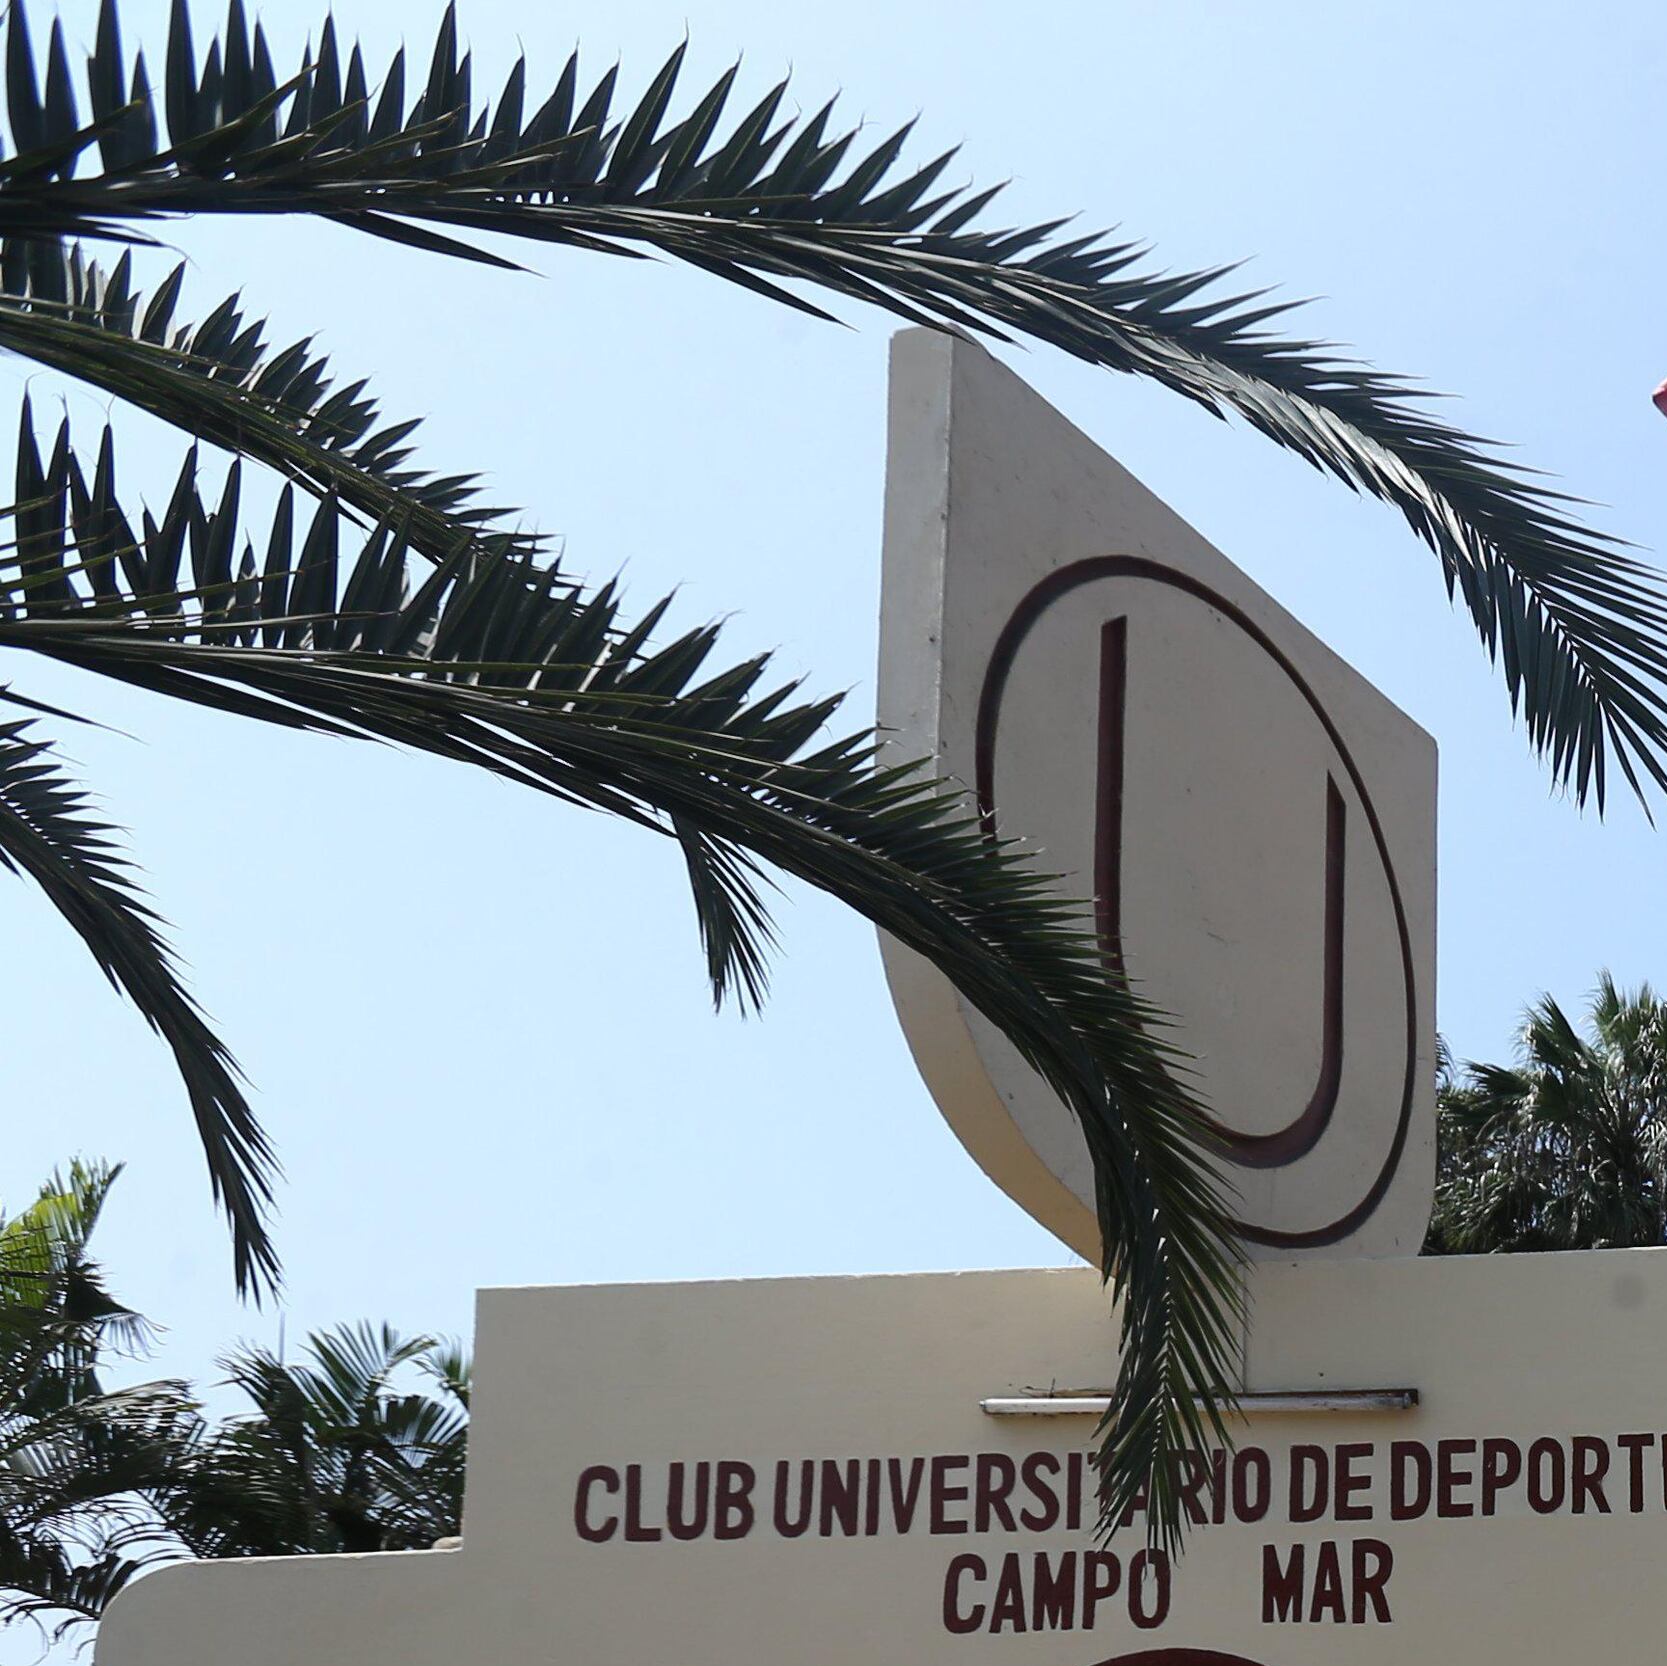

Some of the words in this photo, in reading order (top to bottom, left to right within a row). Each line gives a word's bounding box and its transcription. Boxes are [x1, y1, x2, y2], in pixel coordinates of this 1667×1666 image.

[575, 1461, 756, 1543] CLUB
[1288, 1443, 1374, 1523] DE
[943, 1548, 1171, 1634] CAMPO
[1262, 1538, 1394, 1624] MAR
